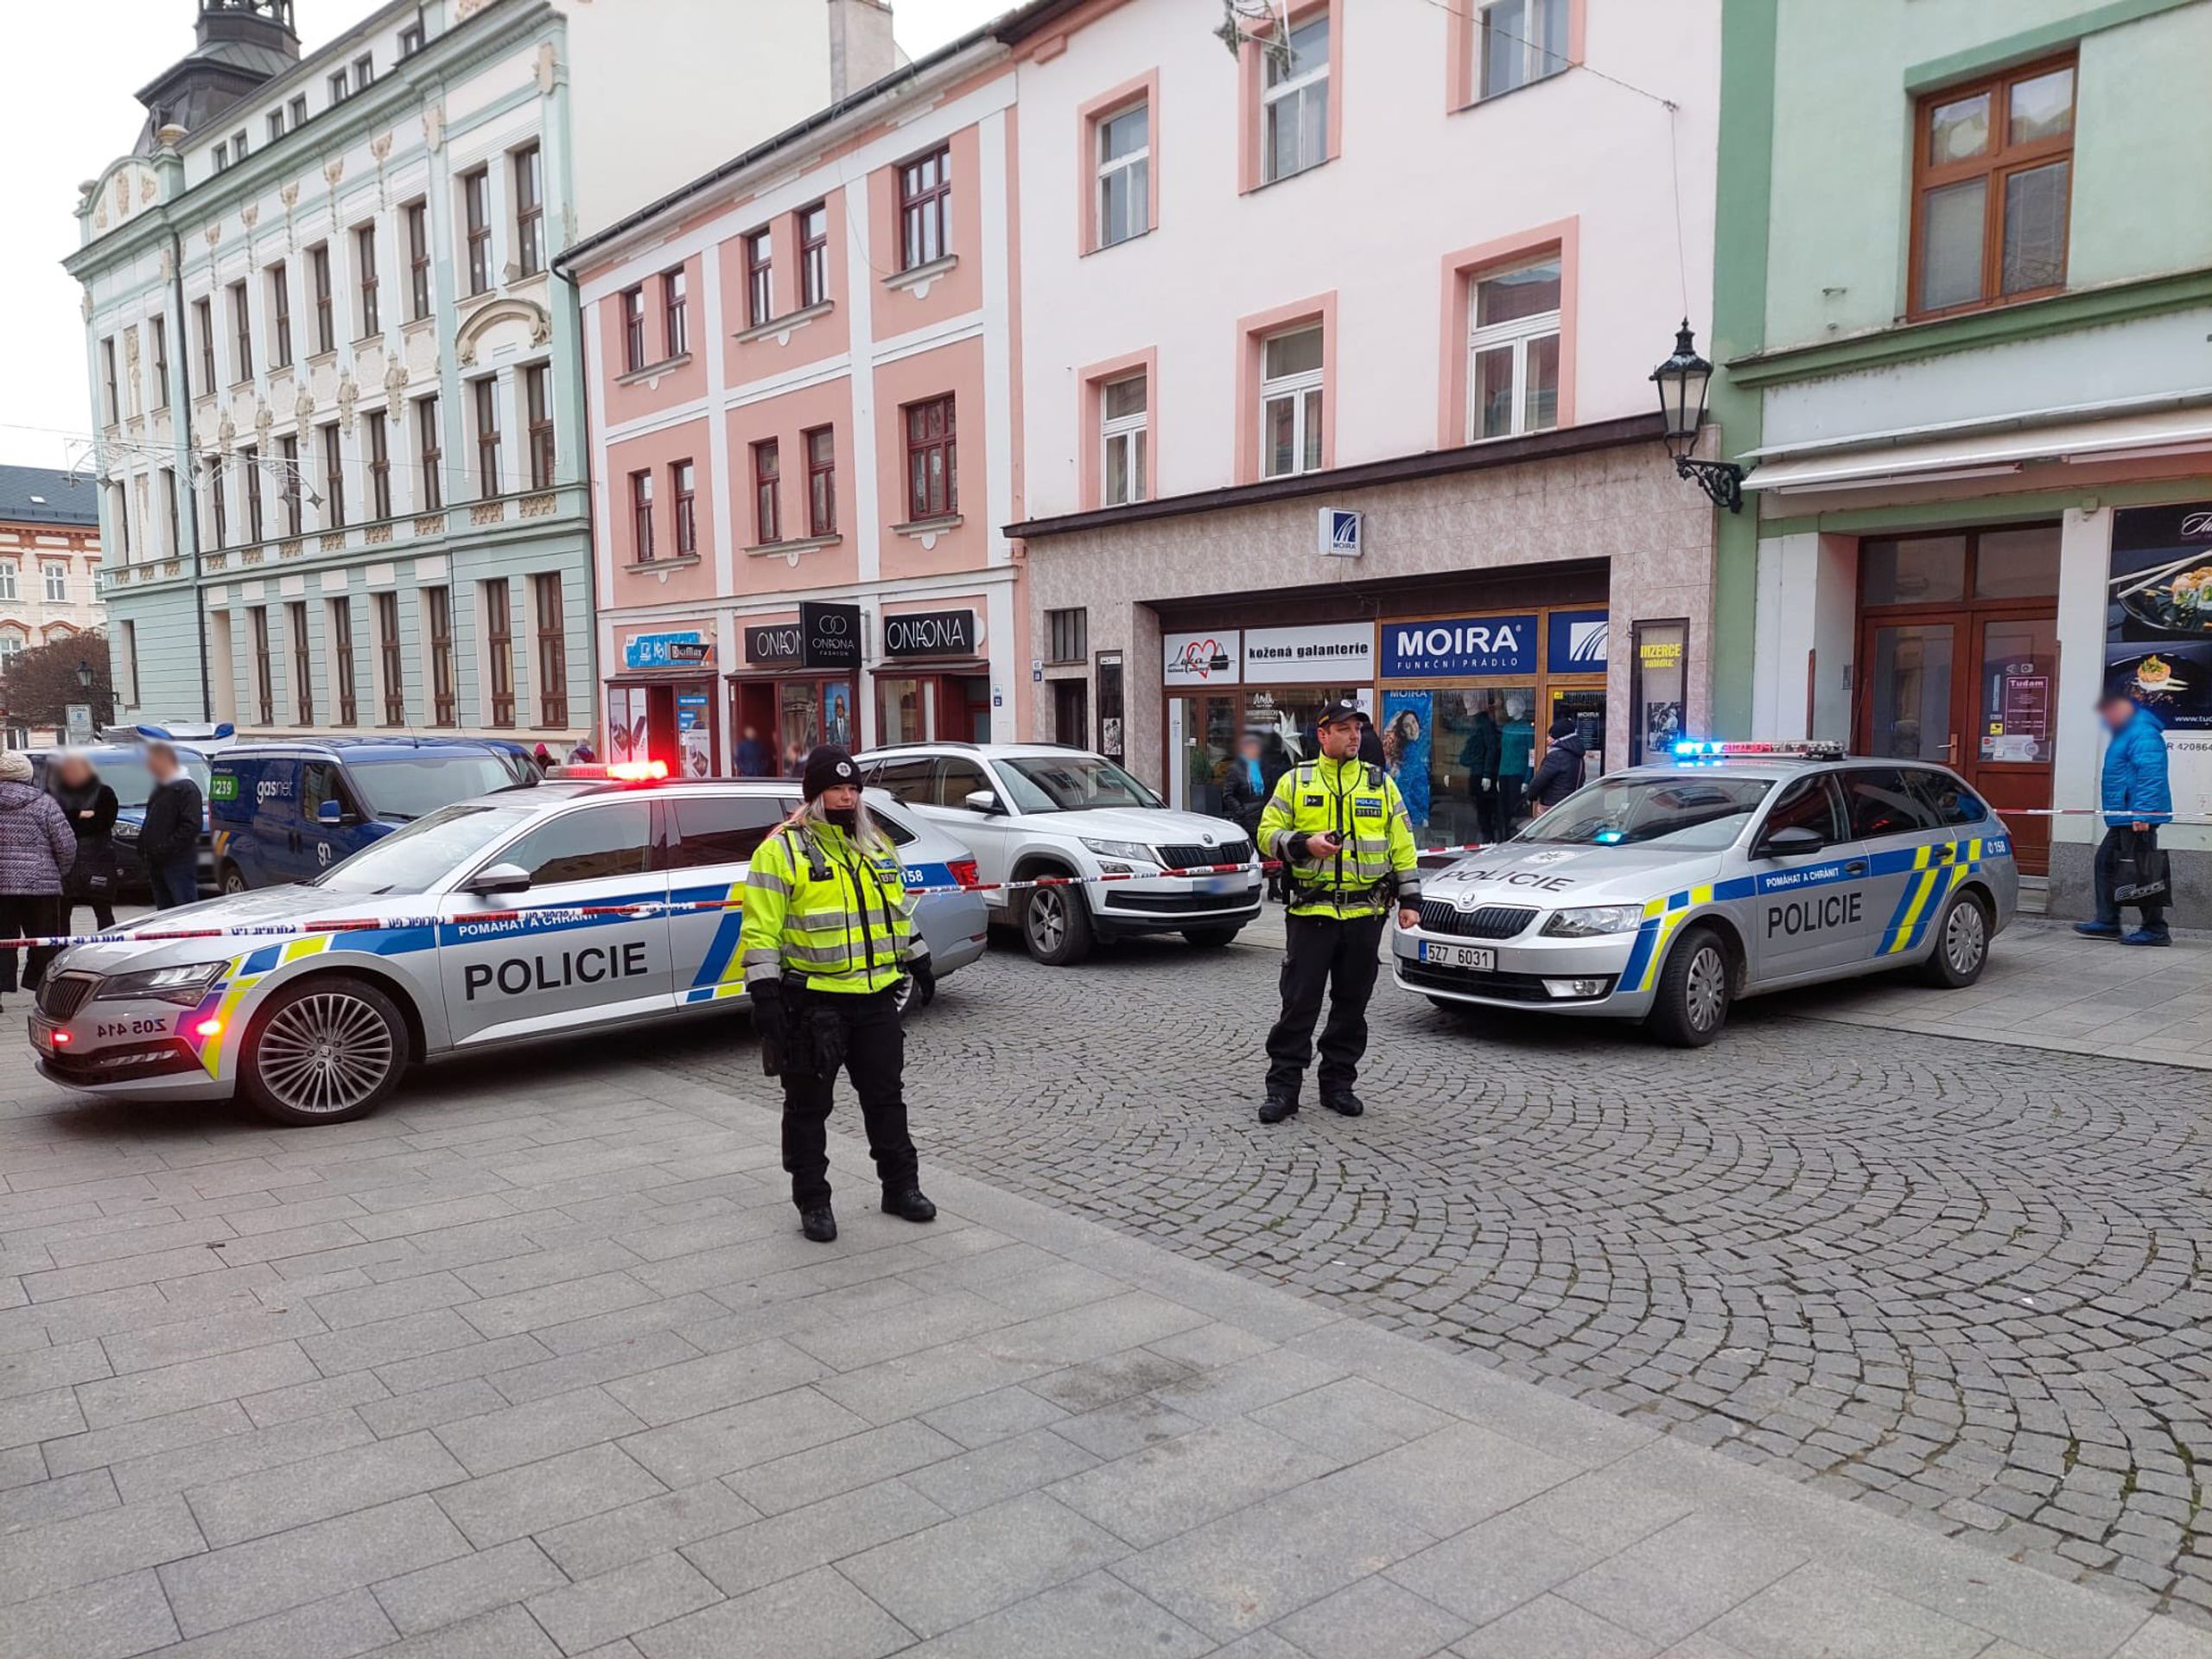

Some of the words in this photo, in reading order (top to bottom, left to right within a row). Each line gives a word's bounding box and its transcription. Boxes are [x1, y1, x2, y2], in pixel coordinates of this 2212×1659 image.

[1249, 646, 1293, 659] kožená
[1297, 642, 1369, 658] galanterie
[1396, 625, 1519, 657] MOIRA
[1397, 658, 1455, 671] FUNKČNÍ
[1463, 657, 1518, 668] PRÁDLO
[257, 779, 293, 804] gasnet
[900, 869, 924, 883] 158
[1434, 870, 1576, 893] POLICIE
[1765, 874, 1801, 888] POMÁHAT
[1803, 872, 1809, 882] A
[1809, 867, 1840, 880] CHRÁNIT
[1768, 892, 1862, 939] POLICIE
[1428, 944, 1449, 962] 5Z7
[1458, 949, 1488, 967] 6031
[464, 941, 648, 1001] POLICIE
